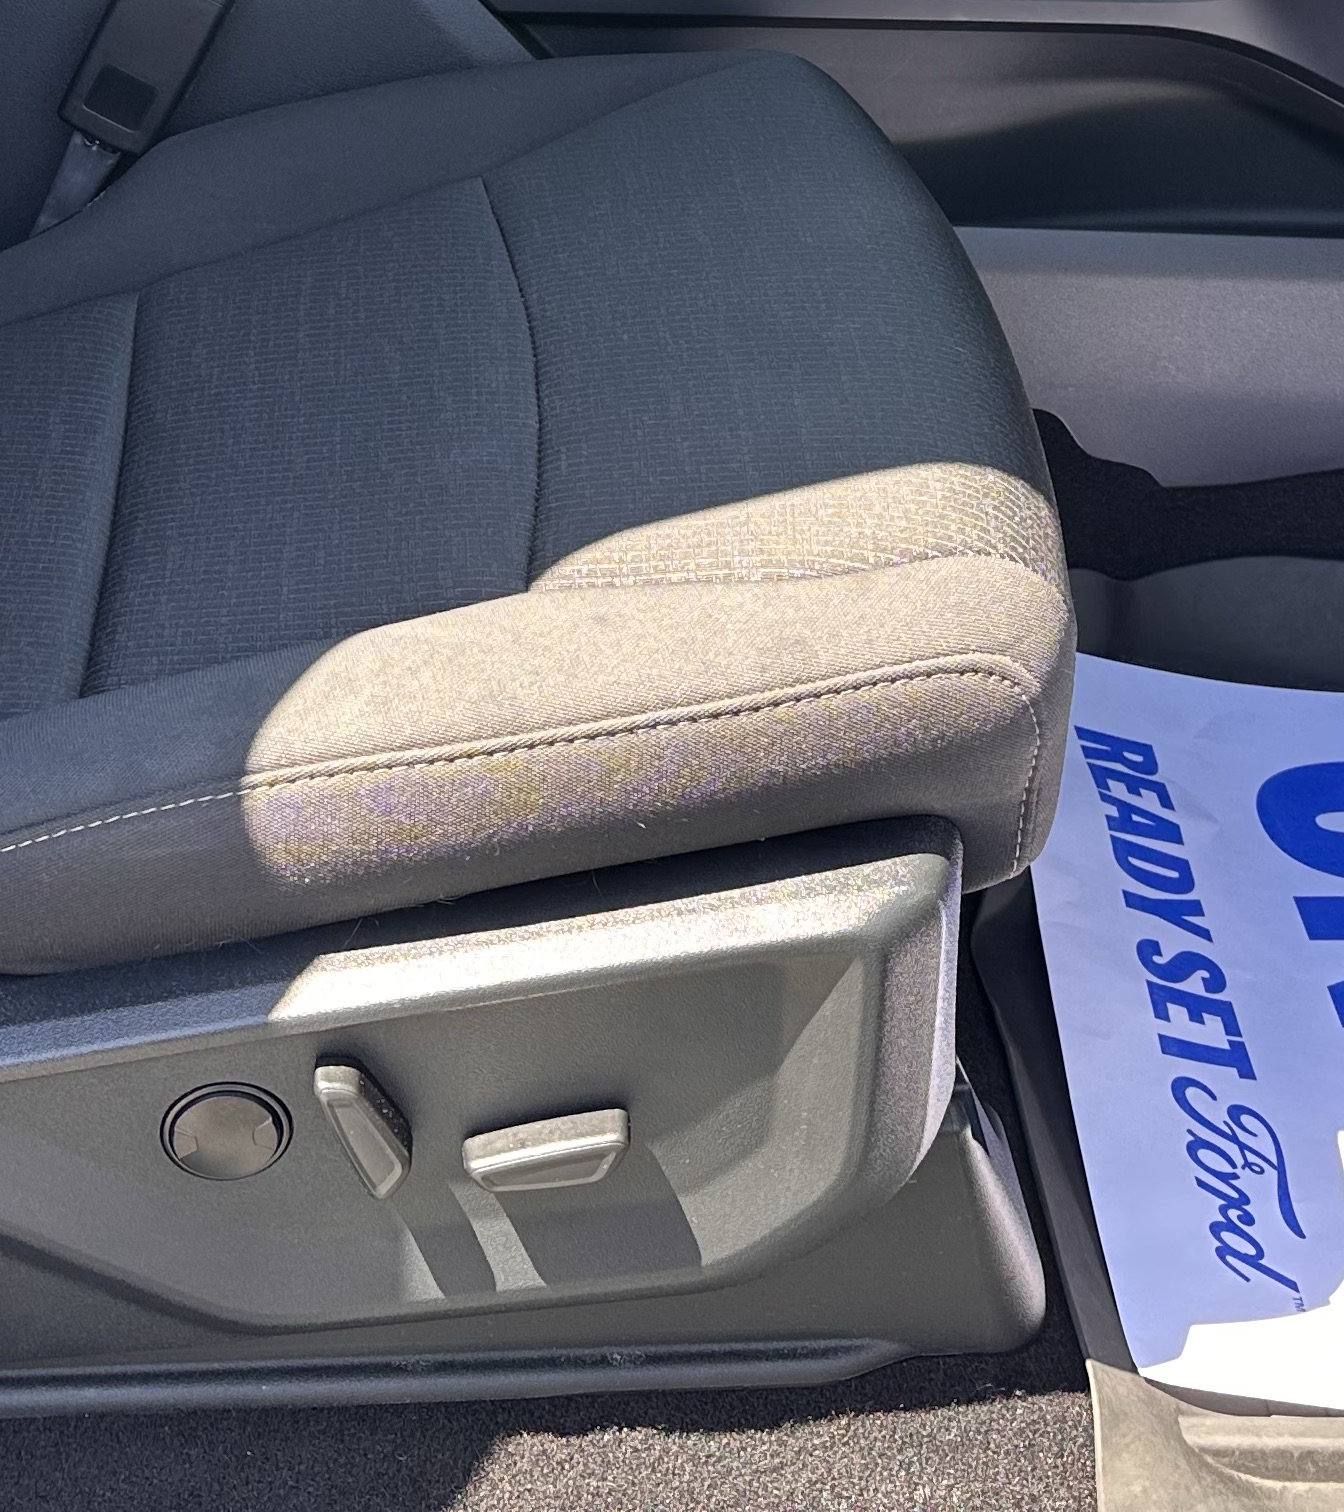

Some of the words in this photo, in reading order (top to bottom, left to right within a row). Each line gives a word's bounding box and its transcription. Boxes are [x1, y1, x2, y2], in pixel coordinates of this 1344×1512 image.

[1073, 725, 1214, 943] READY
[1136, 938, 1258, 1081] SET
[1168, 1074, 1307, 1294] Ford
